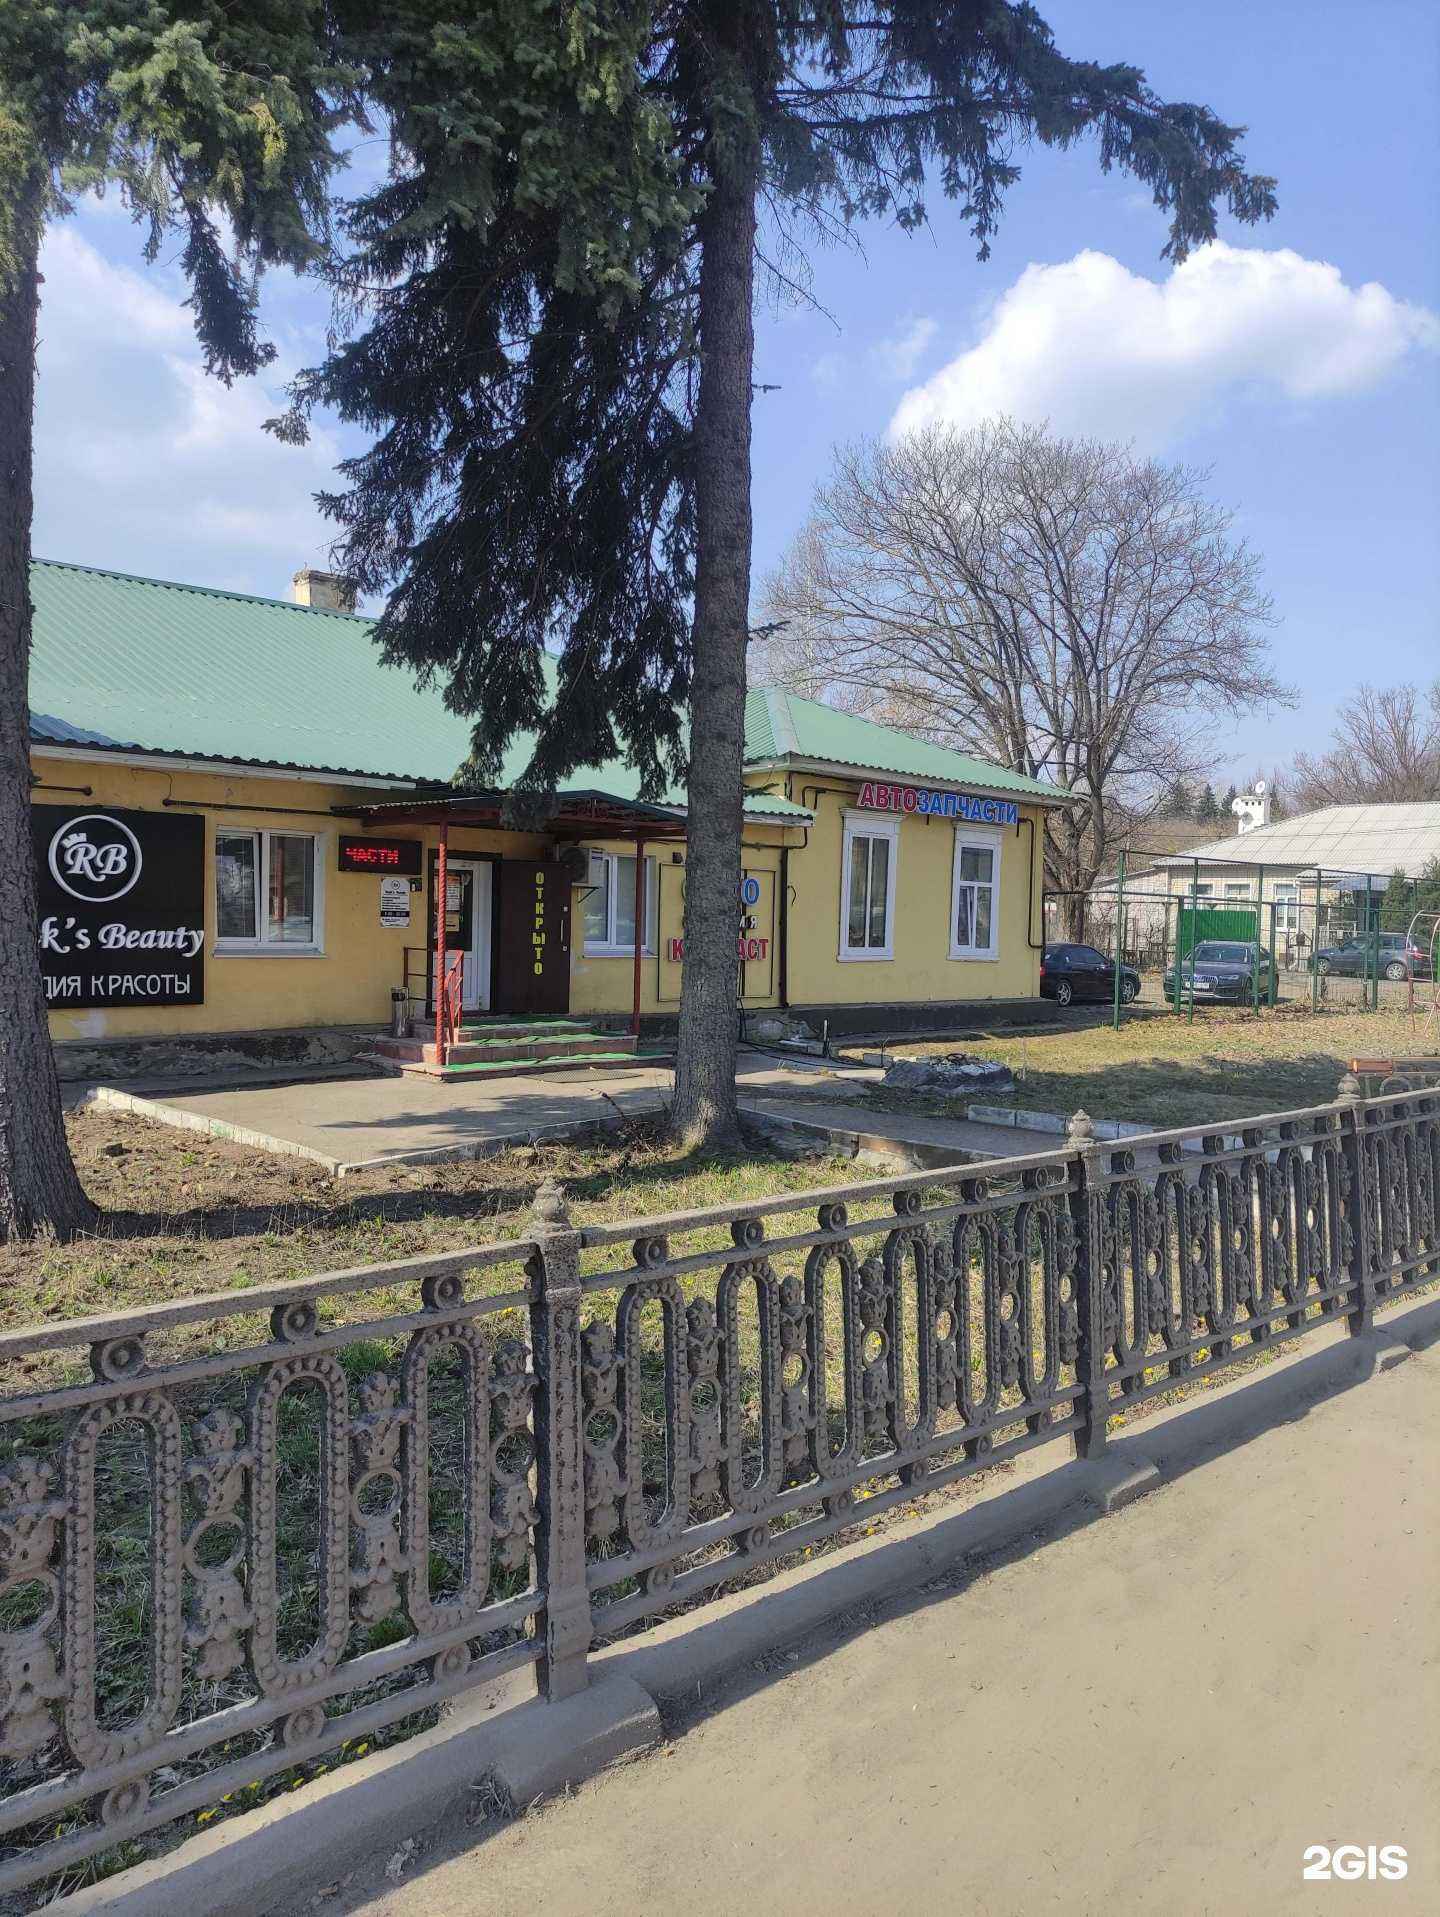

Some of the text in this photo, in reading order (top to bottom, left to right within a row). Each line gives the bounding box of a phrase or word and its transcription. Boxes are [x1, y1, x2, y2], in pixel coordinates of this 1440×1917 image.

[857, 782, 1019, 825] АВТОЗАПЧАСТИ
[64, 842, 128, 882] RB
[38, 916, 205, 958] k's Beauty
[532, 871, 546, 975] ОТКРЫТО
[90, 973, 191, 997] КРАСОТЫ
